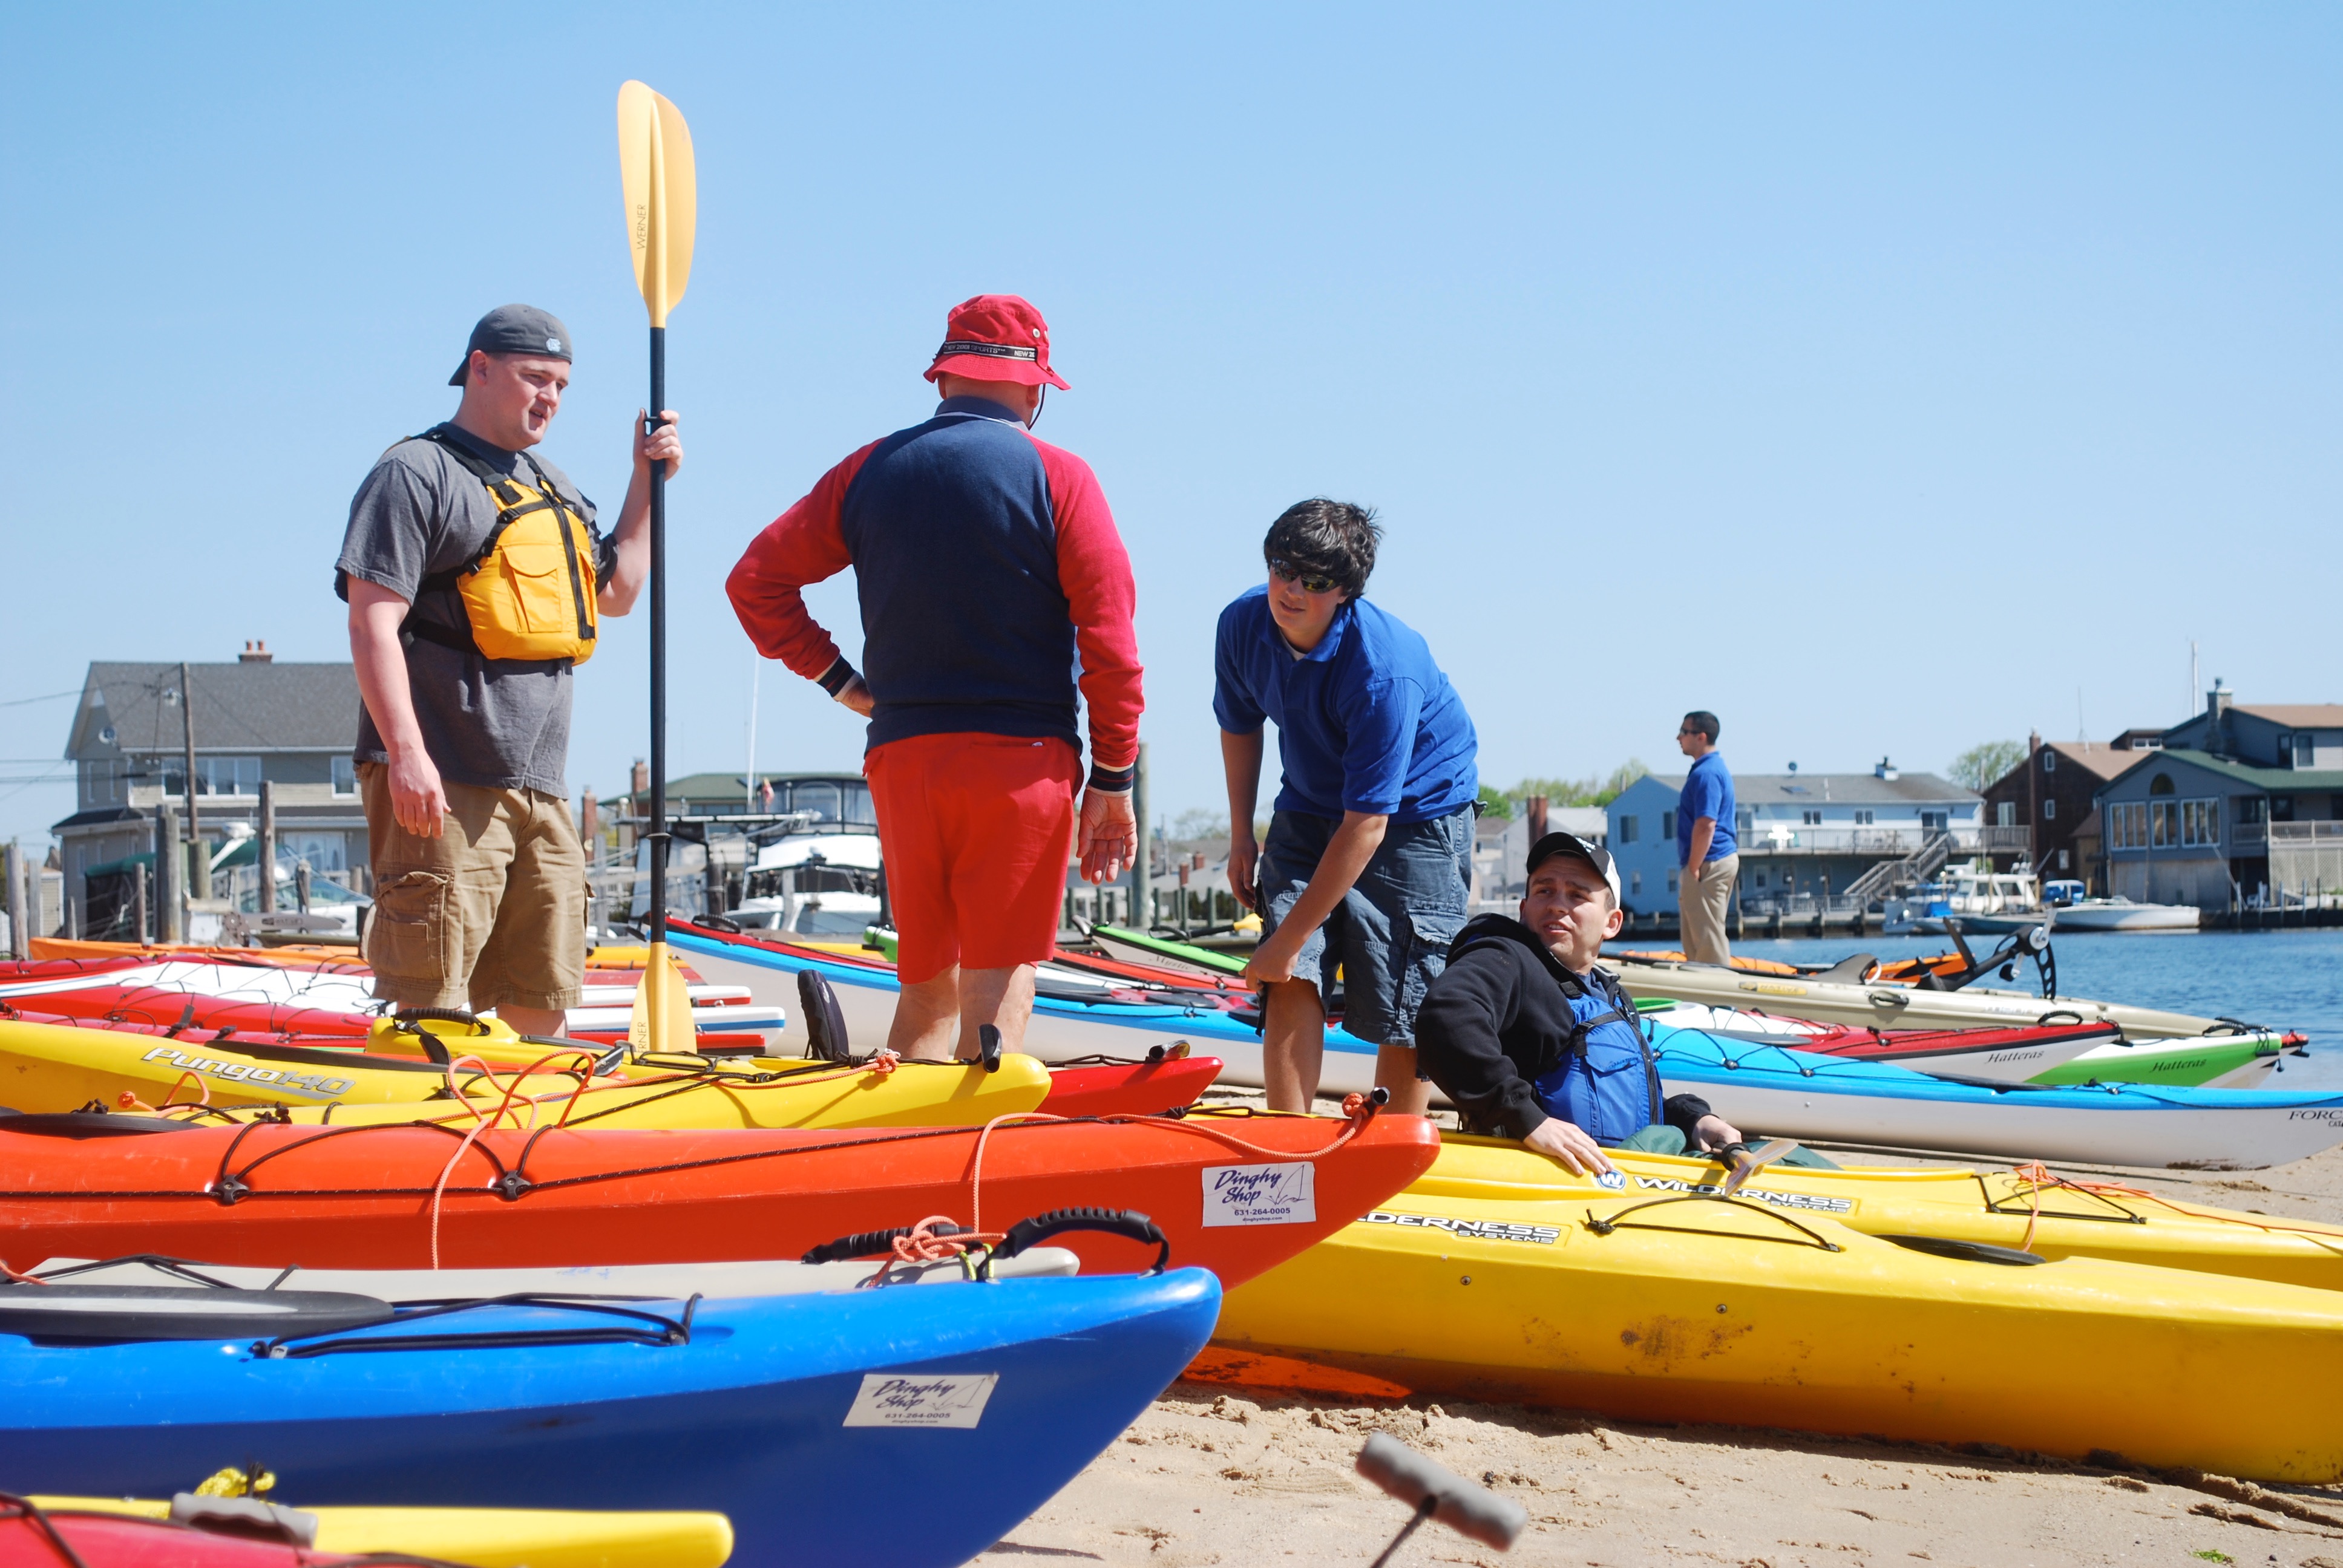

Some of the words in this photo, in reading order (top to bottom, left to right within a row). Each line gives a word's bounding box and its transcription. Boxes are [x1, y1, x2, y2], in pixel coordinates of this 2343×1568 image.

[636, 203, 647, 250] WERNER
[1149, 955, 1191, 970] Mystic
[637, 1021, 647, 1053] ERNER
[1984, 1050, 2045, 1065] Hatteras
[2149, 1059, 2207, 1073] Hatteras
[2289, 1109, 2343, 1120] FORC
[1214, 1167, 1283, 1191] Dinghy
[1222, 1186, 1262, 1206] Shop
[1234, 1207, 1291, 1217] 631-264-0005
[1770, 1200, 1849, 1214] SYSTEMS
[1357, 1211, 1561, 1238] DERNESS
[1457, 1229, 1557, 1245] SYSTEMS
[872, 1379, 957, 1398] Dinghy
[876, 1395, 926, 1411] Shop
